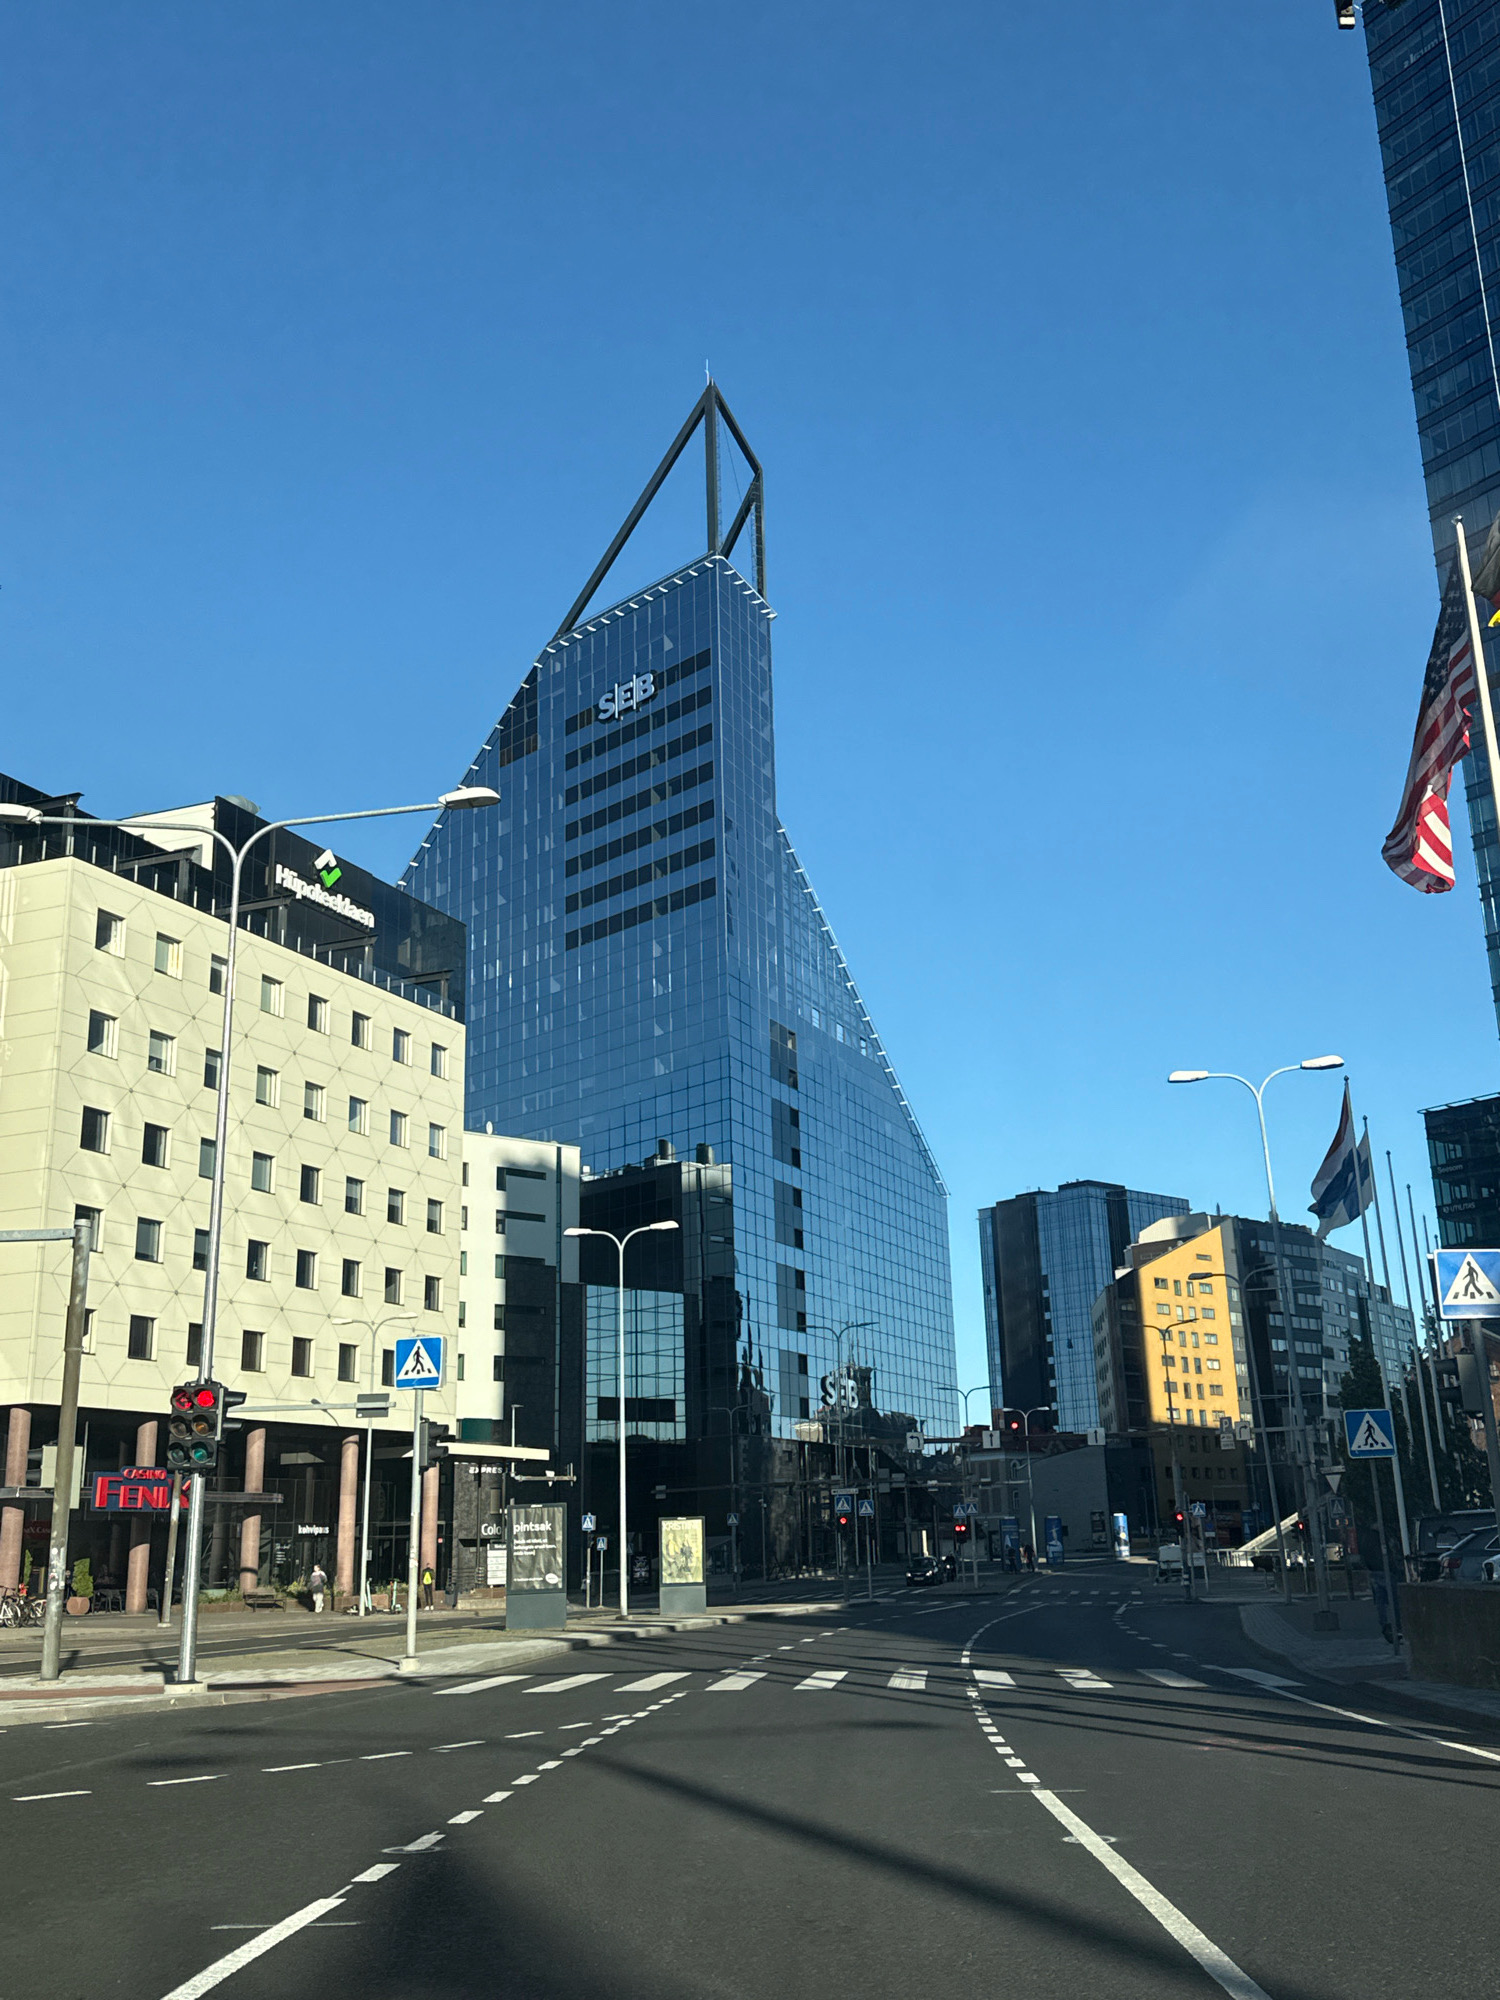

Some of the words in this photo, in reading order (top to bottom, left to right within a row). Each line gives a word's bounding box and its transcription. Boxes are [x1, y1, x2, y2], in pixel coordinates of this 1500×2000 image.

[598, 672, 654, 719] SEB
[276, 864, 374, 928] Hüpoteeklaen
[123, 1468, 167, 1480] CASINO
[469, 1466, 507, 1474] EXPRES
[513, 1521, 552, 1534] pintsak
